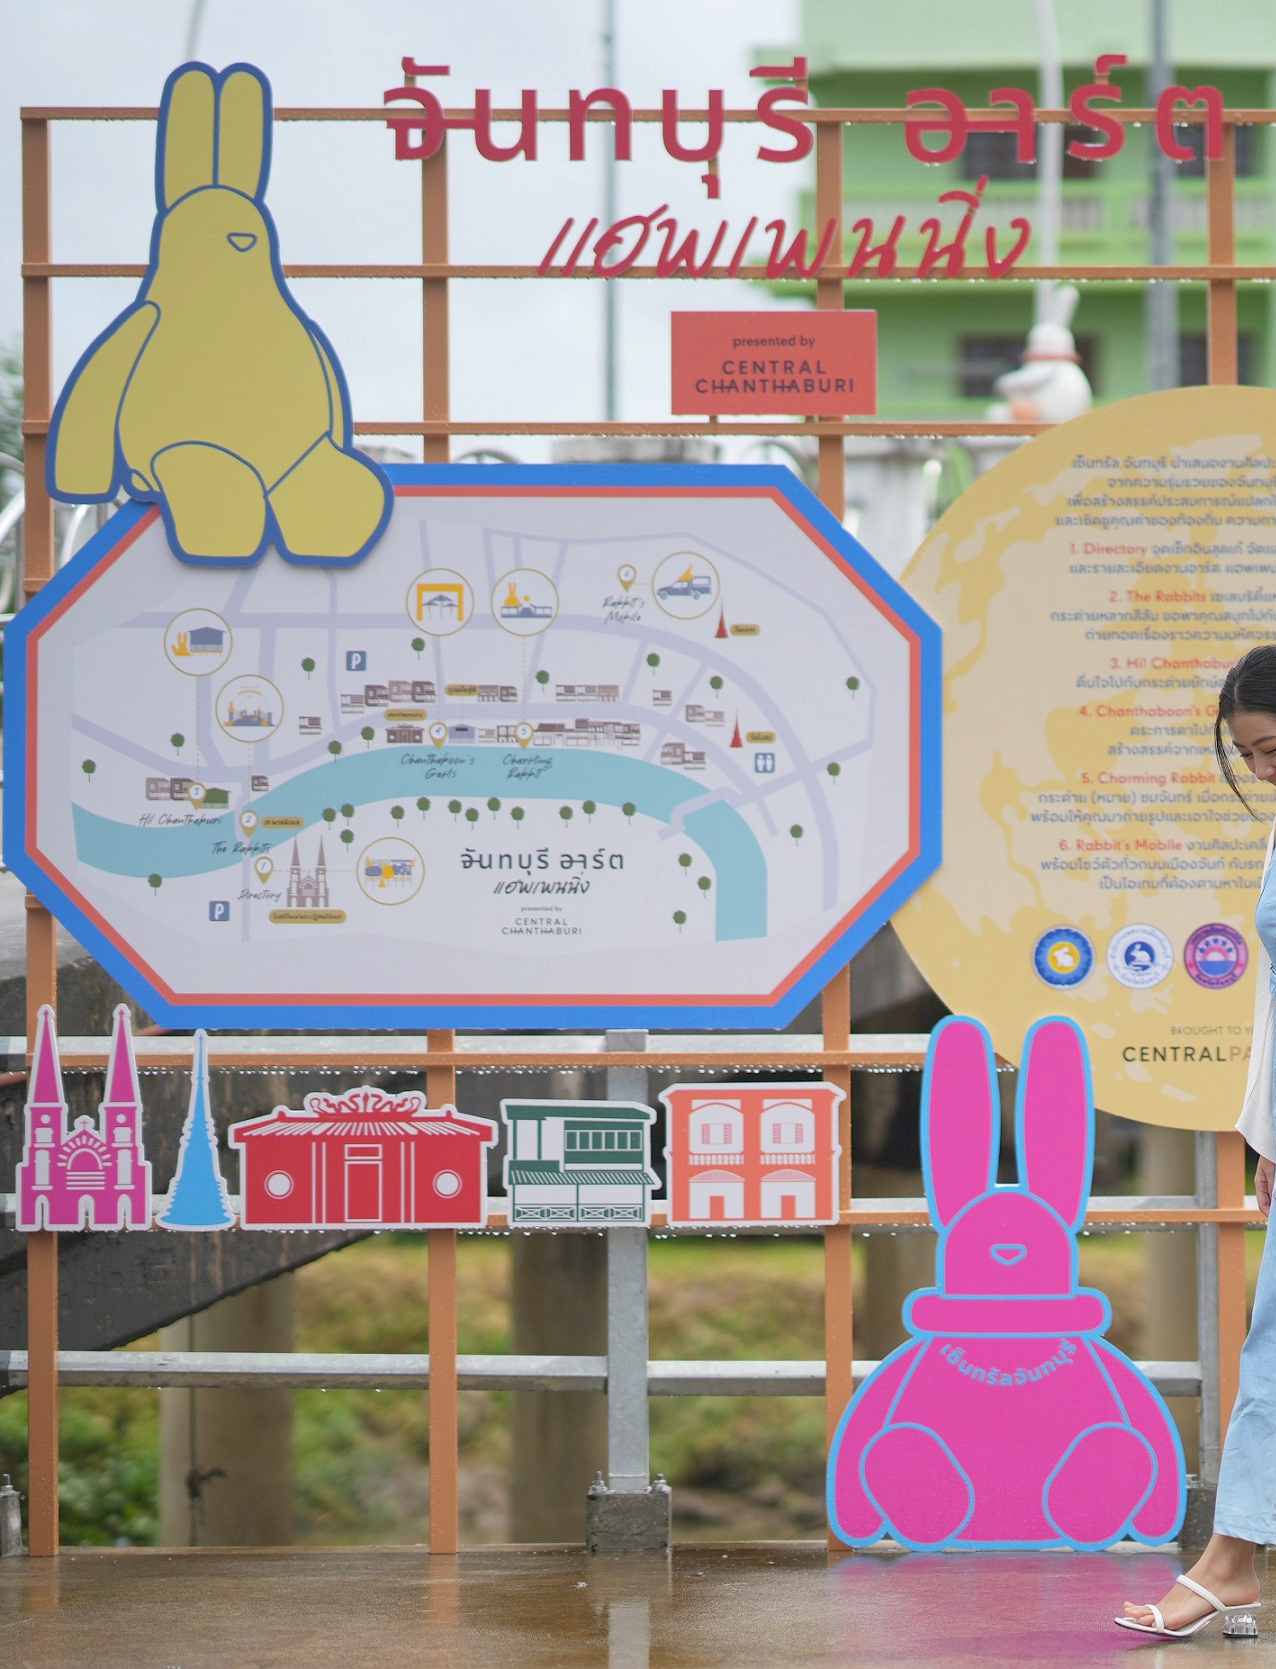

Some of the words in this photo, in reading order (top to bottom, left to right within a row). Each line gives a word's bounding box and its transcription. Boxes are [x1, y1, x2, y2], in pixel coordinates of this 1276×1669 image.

[382, 56, 815, 199] จันทบุรี
[904, 54, 1226, 163] อาร์ต
[536, 175, 1030, 278] แฮพเพนนิ่ง
[733, 336, 796, 349] presented
[800, 336, 815, 349] by
[722, 360, 827, 375] CENTRAL
[695, 378, 854, 394] CHANTHABURI
[1083, 542, 1147, 557] Directory
[1127, 590, 1152, 602] The
[1156, 590, 1207, 602] Rabbits
[1152, 656, 1238, 670] Chanthabu
[1098, 772, 1167, 786] Charming
[1170, 772, 1217, 784] Rabbit
[1135, 839, 1184, 851] Mobile
[460, 847, 550, 876] จันทบุรี
[560, 847, 625, 870] อาร์ต
[514, 917, 569, 926] CENTRAL
[501, 927, 583, 936] CHANTHABURI
[1171, 1025, 1224, 1036] BROUGHT
[1227, 1025, 1242, 1036] TO
